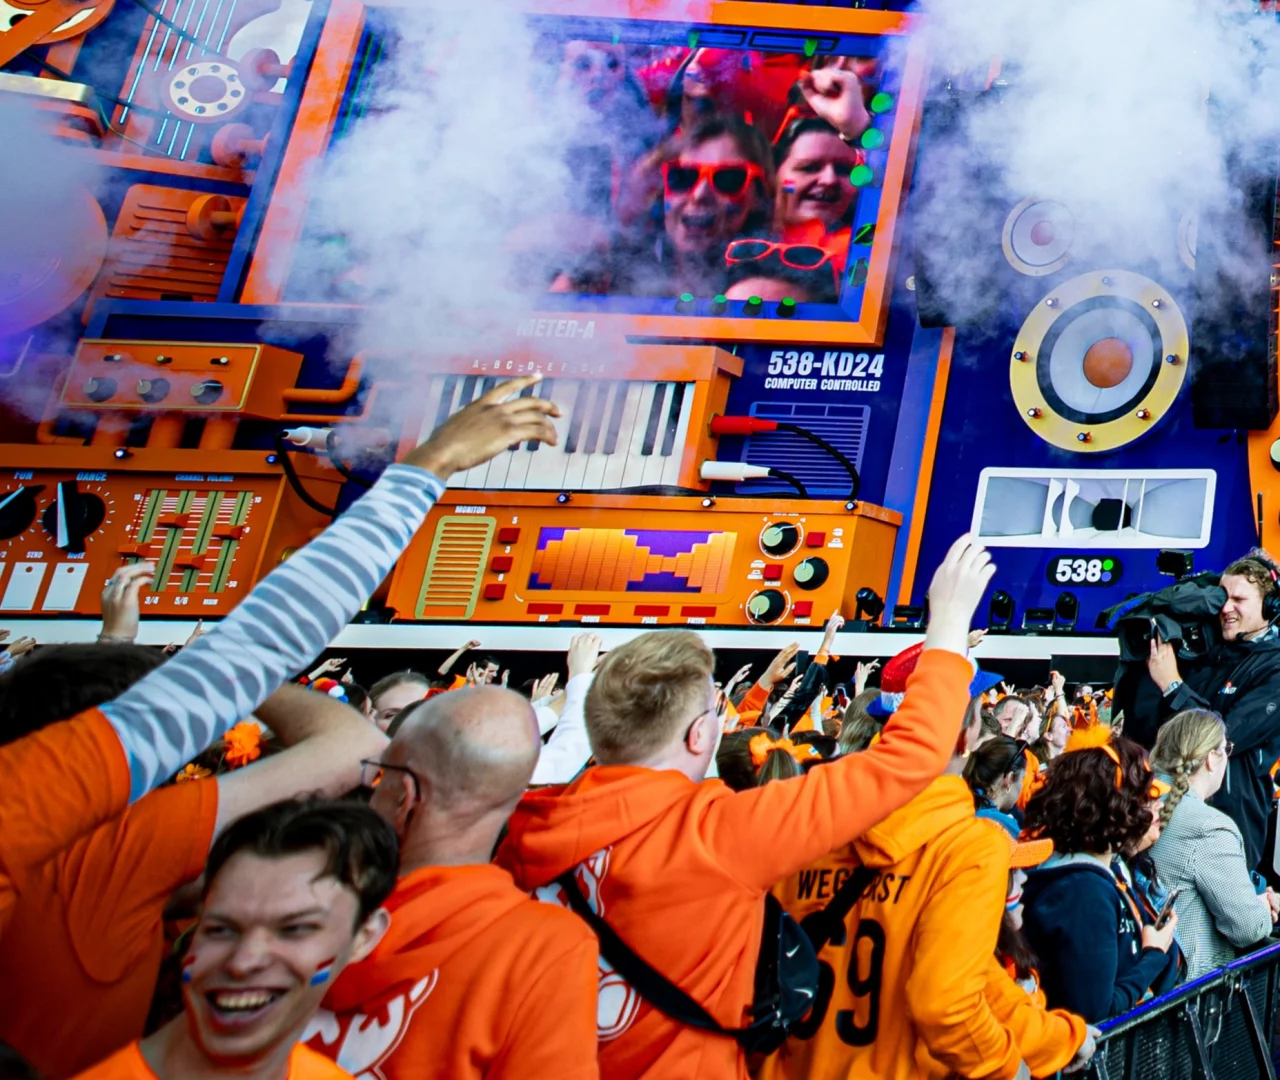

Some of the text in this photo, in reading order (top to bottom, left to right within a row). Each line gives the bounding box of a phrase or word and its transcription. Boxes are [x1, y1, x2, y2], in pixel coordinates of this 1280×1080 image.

[516, 318, 595, 339] METER-A
[768, 351, 885, 378] 538-KD24
[764, 377, 880, 392] COMPUTER CONTROLLED
[76, 471, 107, 481] DANCE
[454, 505, 486, 514] MONITOR
[1055, 559, 1102, 582] 538
[144, 596, 159, 605] 3/4
[174, 596, 189, 605] 5/6
